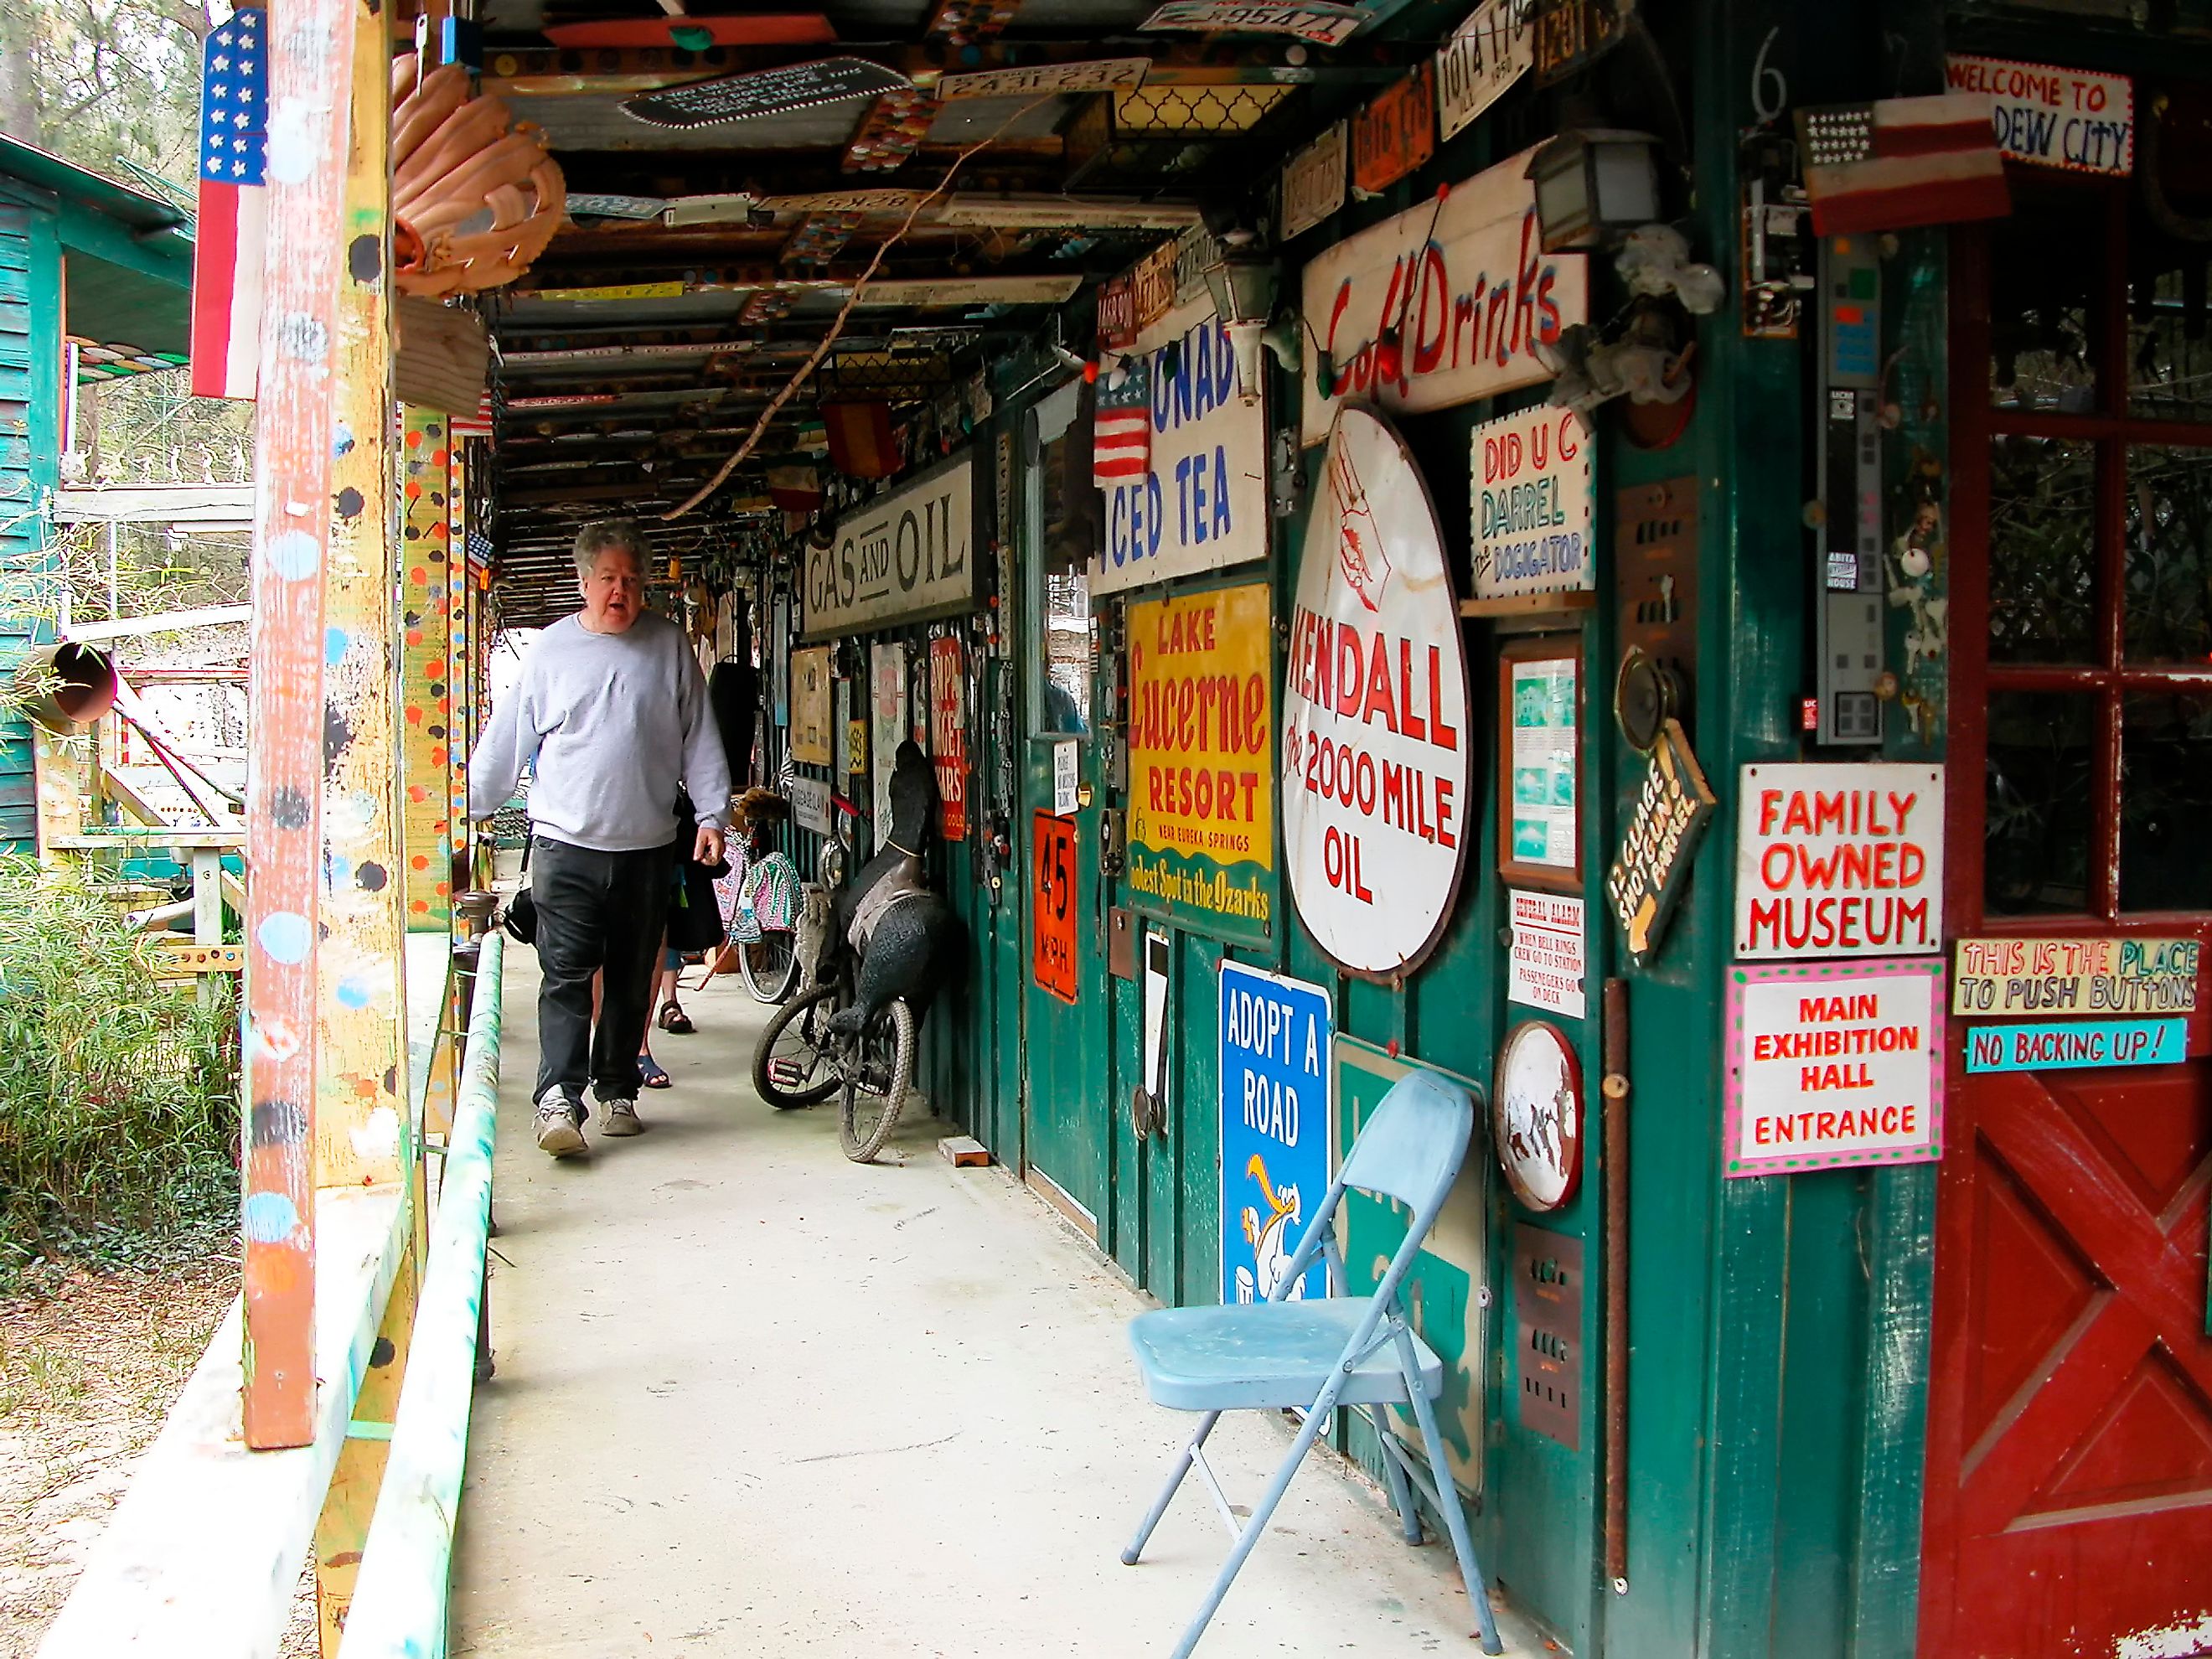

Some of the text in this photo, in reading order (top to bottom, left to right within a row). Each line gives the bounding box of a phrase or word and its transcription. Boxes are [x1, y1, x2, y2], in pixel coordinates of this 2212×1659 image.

[1946, 59, 2107, 112] WELCOME TO
[2064, 118, 2130, 170] CITY
[1414, 204, 1562, 374] Drinks
[1485, 412, 1578, 484] DID U C
[1176, 445, 1232, 546] TEA
[1481, 475, 1565, 540] DARREL
[809, 493, 966, 614] GAS AND OIL
[1158, 607, 1217, 655] LAKE
[1128, 641, 1266, 755] Lucerne
[1289, 604, 1458, 752] KENDALL
[1149, 766, 1259, 822] RESORT
[1305, 730, 1377, 817] 2000
[1382, 759, 1457, 850] MILE
[1759, 789, 1918, 836] FAMILY
[1159, 824, 1249, 853] NEAR EUREKA SPRINGS
[1040, 833, 1067, 921] 45
[1324, 825, 1373, 906] OIL
[1761, 842, 1925, 892] OWNED
[1215, 871, 1269, 921] Ozarks
[1538, 935, 1553, 951] BELL
[1749, 897, 1929, 949] MUSEUM
[1532, 950, 1543, 964] GO
[1543, 953, 1553, 967] TO
[1963, 940, 2199, 976] THIS IS THE PLACE
[1800, 995, 1879, 1023] MAIN
[1959, 977, 1997, 1010] TO
[2005, 975, 2080, 1010] PUSH
[1228, 989, 1320, 1077] ADOPT A
[1754, 1026, 1920, 1061] EXHIBITION
[1972, 1032, 2003, 1067] NO
[2014, 1031, 2106, 1064] BACKING
[1801, 1062, 1875, 1092] HALL
[1244, 1068, 1299, 1147] ROAD
[1755, 1104, 1916, 1145] ENTRANCE
